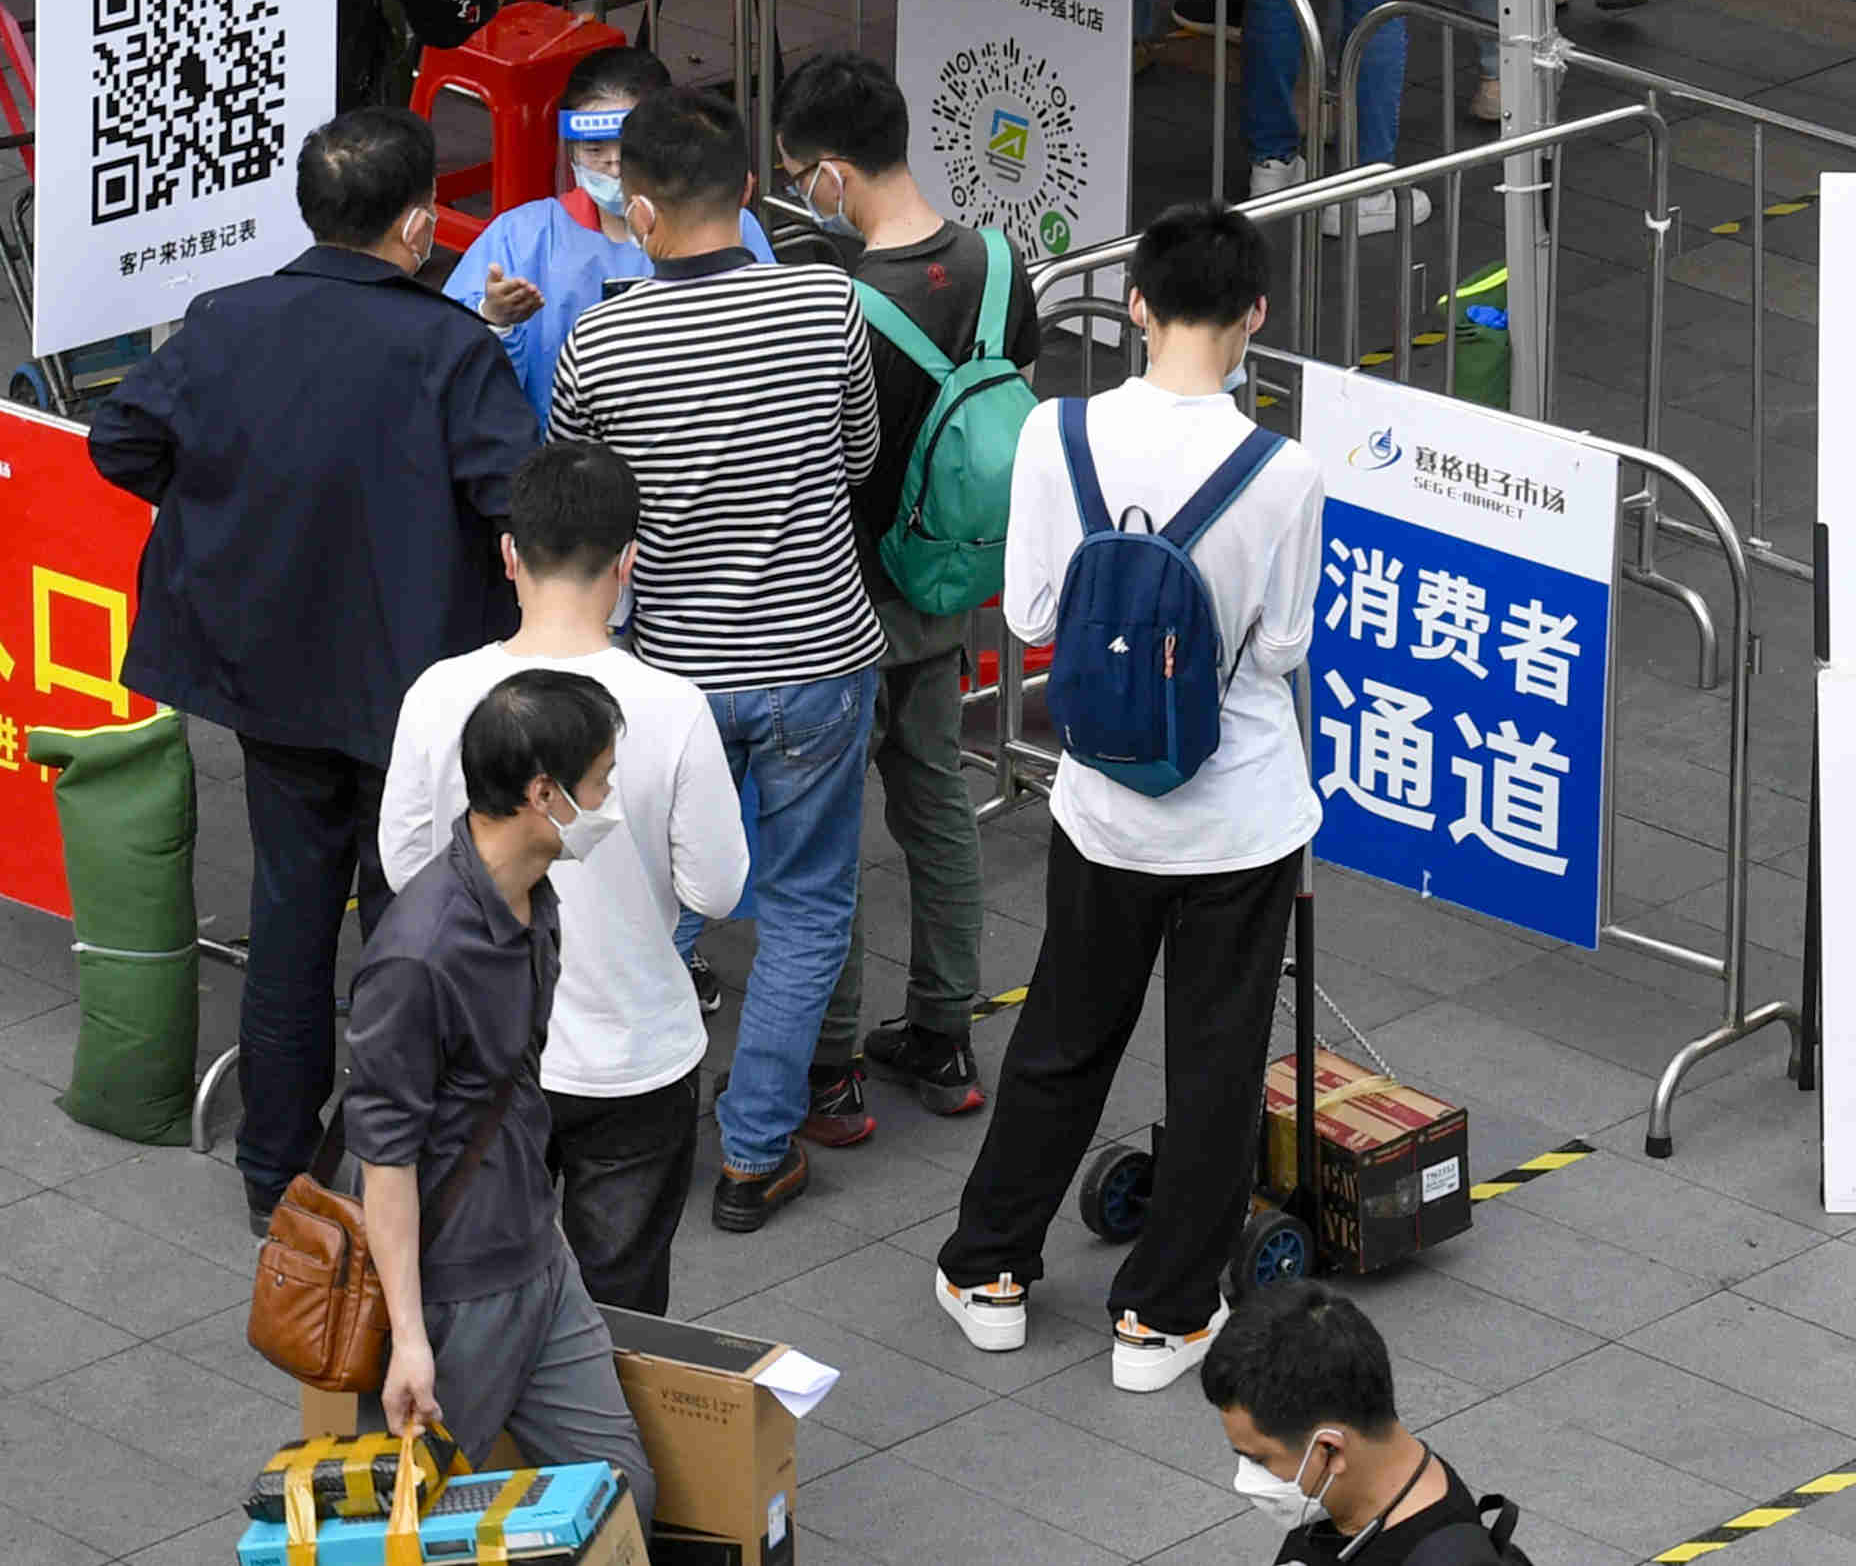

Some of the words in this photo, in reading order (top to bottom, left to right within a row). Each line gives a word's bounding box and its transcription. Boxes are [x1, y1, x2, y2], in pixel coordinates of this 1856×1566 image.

[118, 218, 258, 277] 客户来访登记表
[1413, 473, 1444, 498] SEG
[1446, 484, 1526, 522] E-MARKET
[1414, 444, 1567, 516] 赛格电子市场
[1323, 537, 1582, 707] 消费者
[1318, 668, 1571, 877] 通道
